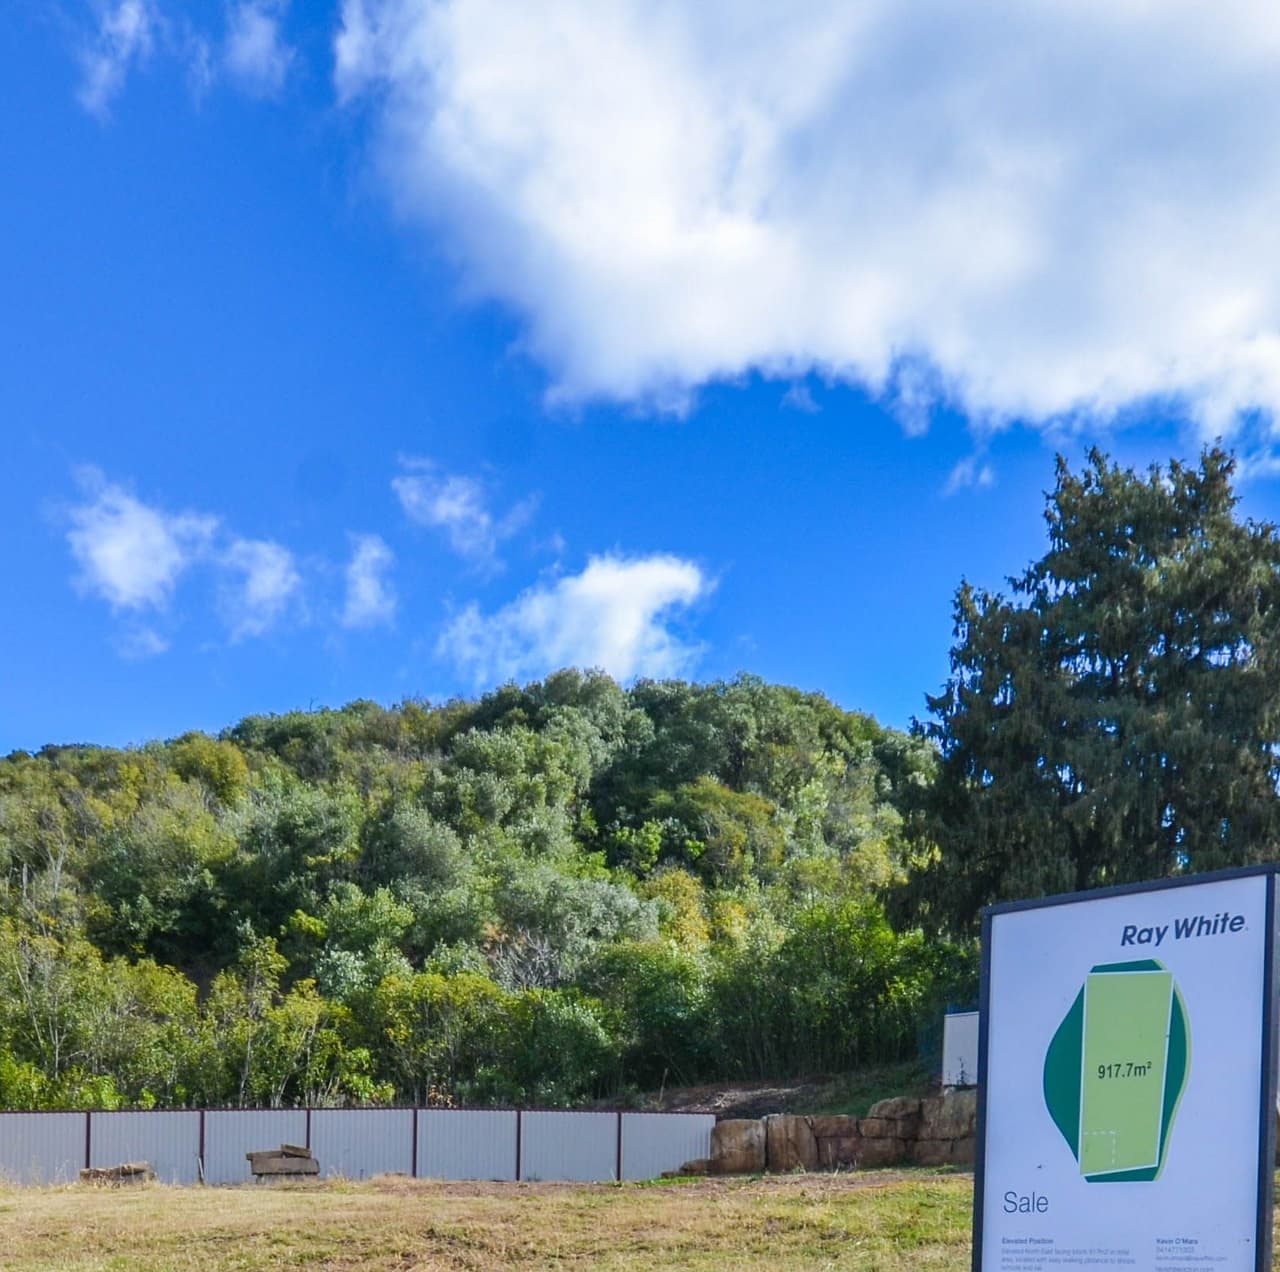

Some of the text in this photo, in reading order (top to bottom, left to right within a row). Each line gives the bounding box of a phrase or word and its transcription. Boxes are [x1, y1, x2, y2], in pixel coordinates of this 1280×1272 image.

[1120, 912, 1246, 947] Ray White
[1004, 1191, 1049, 1214] Sale
